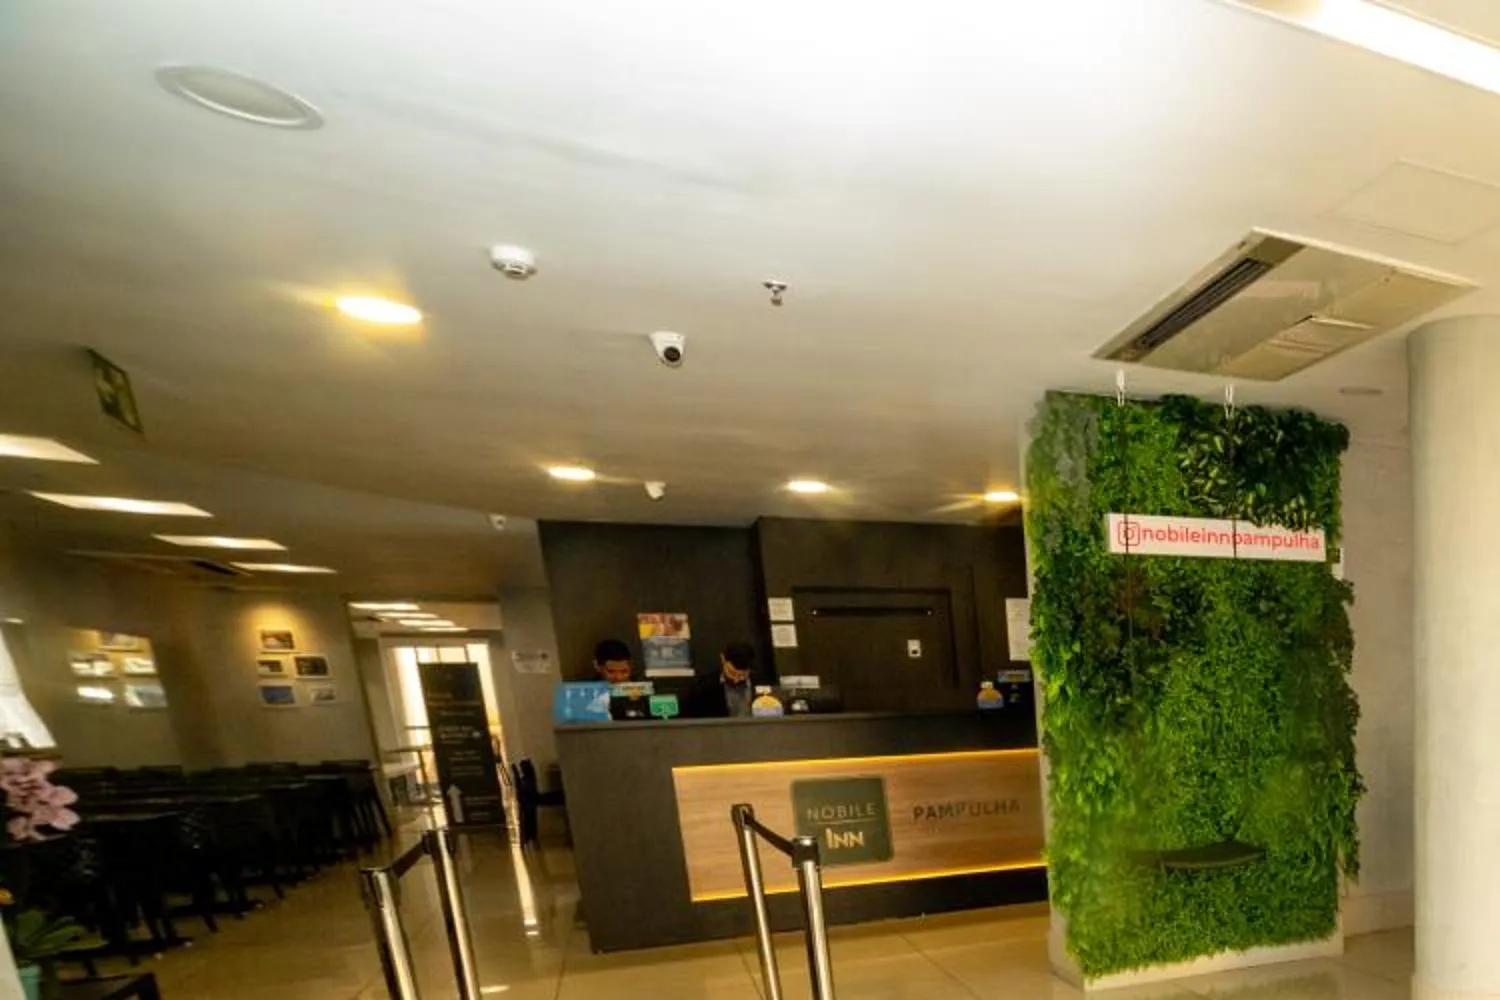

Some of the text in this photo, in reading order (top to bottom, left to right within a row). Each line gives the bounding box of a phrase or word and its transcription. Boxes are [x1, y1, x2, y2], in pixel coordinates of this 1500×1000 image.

[807, 802, 877, 820] NOBILE
[912, 800, 1022, 820] PAMPULHA
[825, 828, 864, 848] INN
